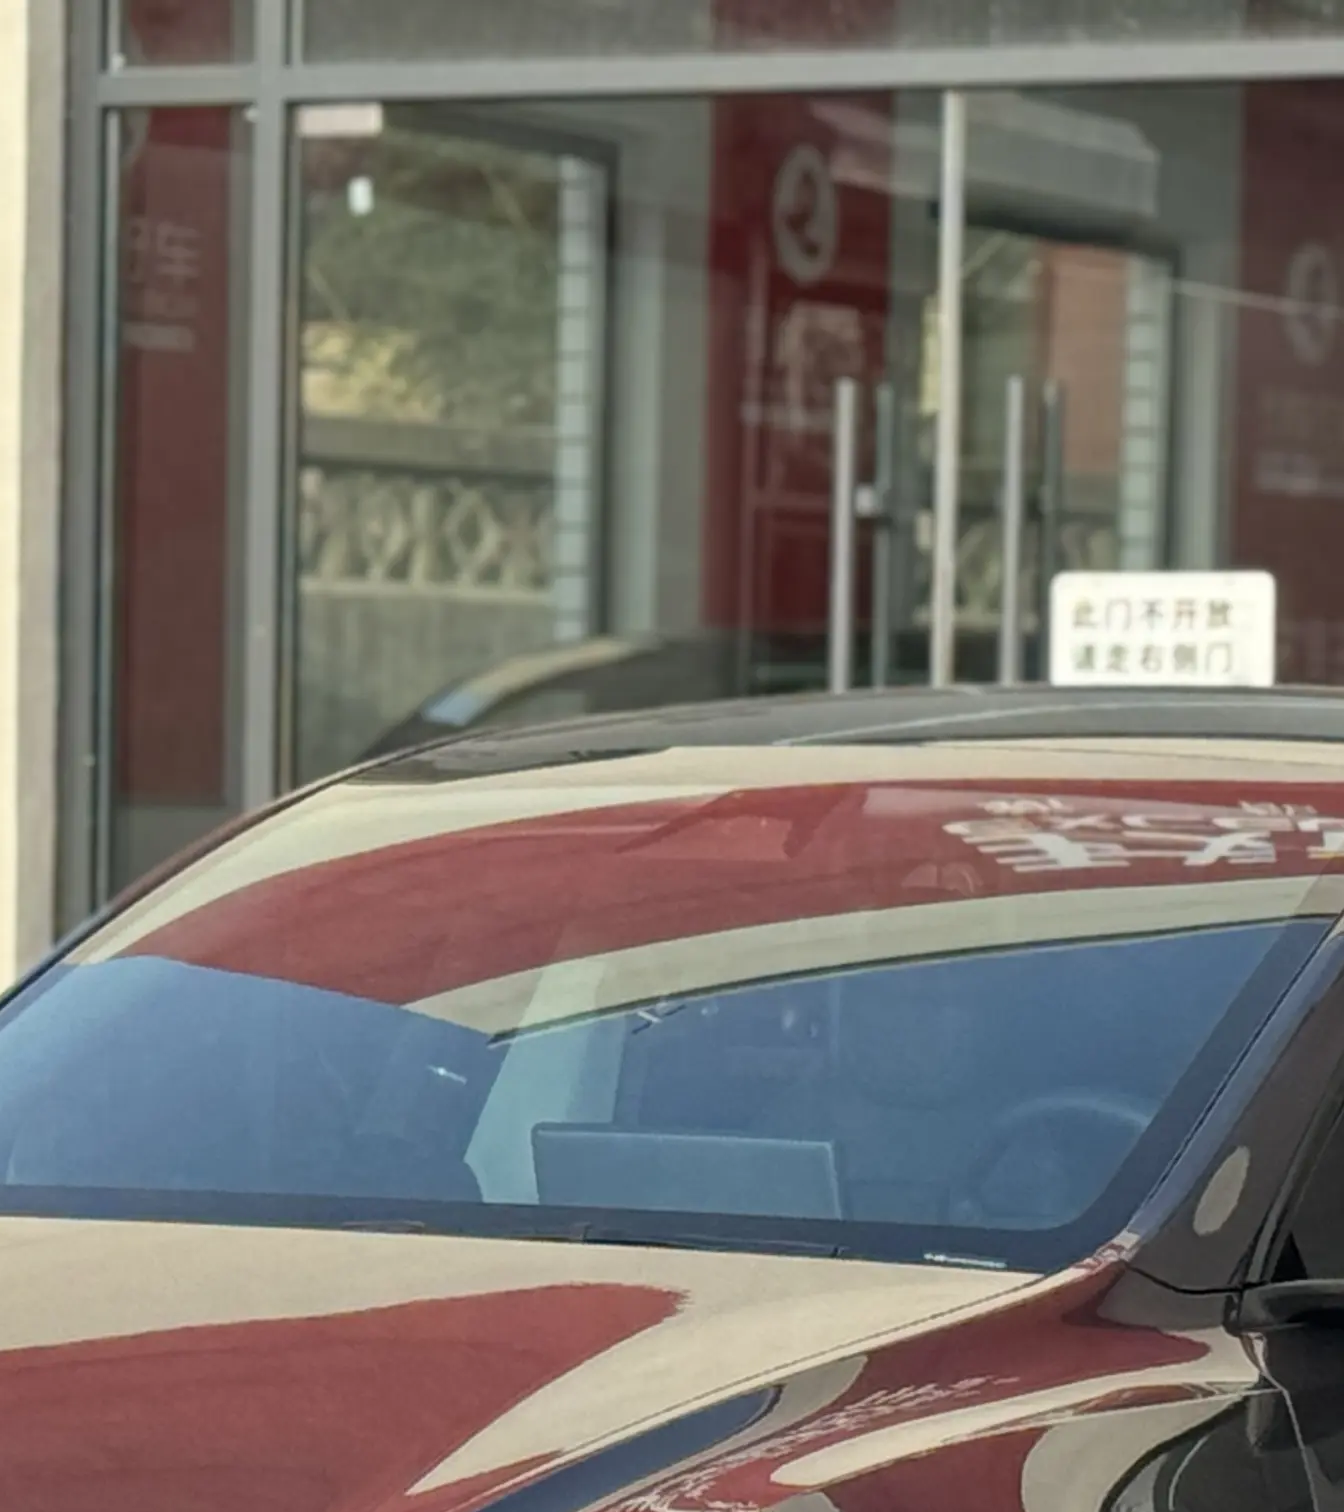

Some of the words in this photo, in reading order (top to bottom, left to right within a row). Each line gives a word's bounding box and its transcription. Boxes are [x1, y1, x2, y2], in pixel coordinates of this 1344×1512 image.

[1072, 598, 1233, 632] 此门不开放
[1073, 641, 1233, 674] 请走右侧门
